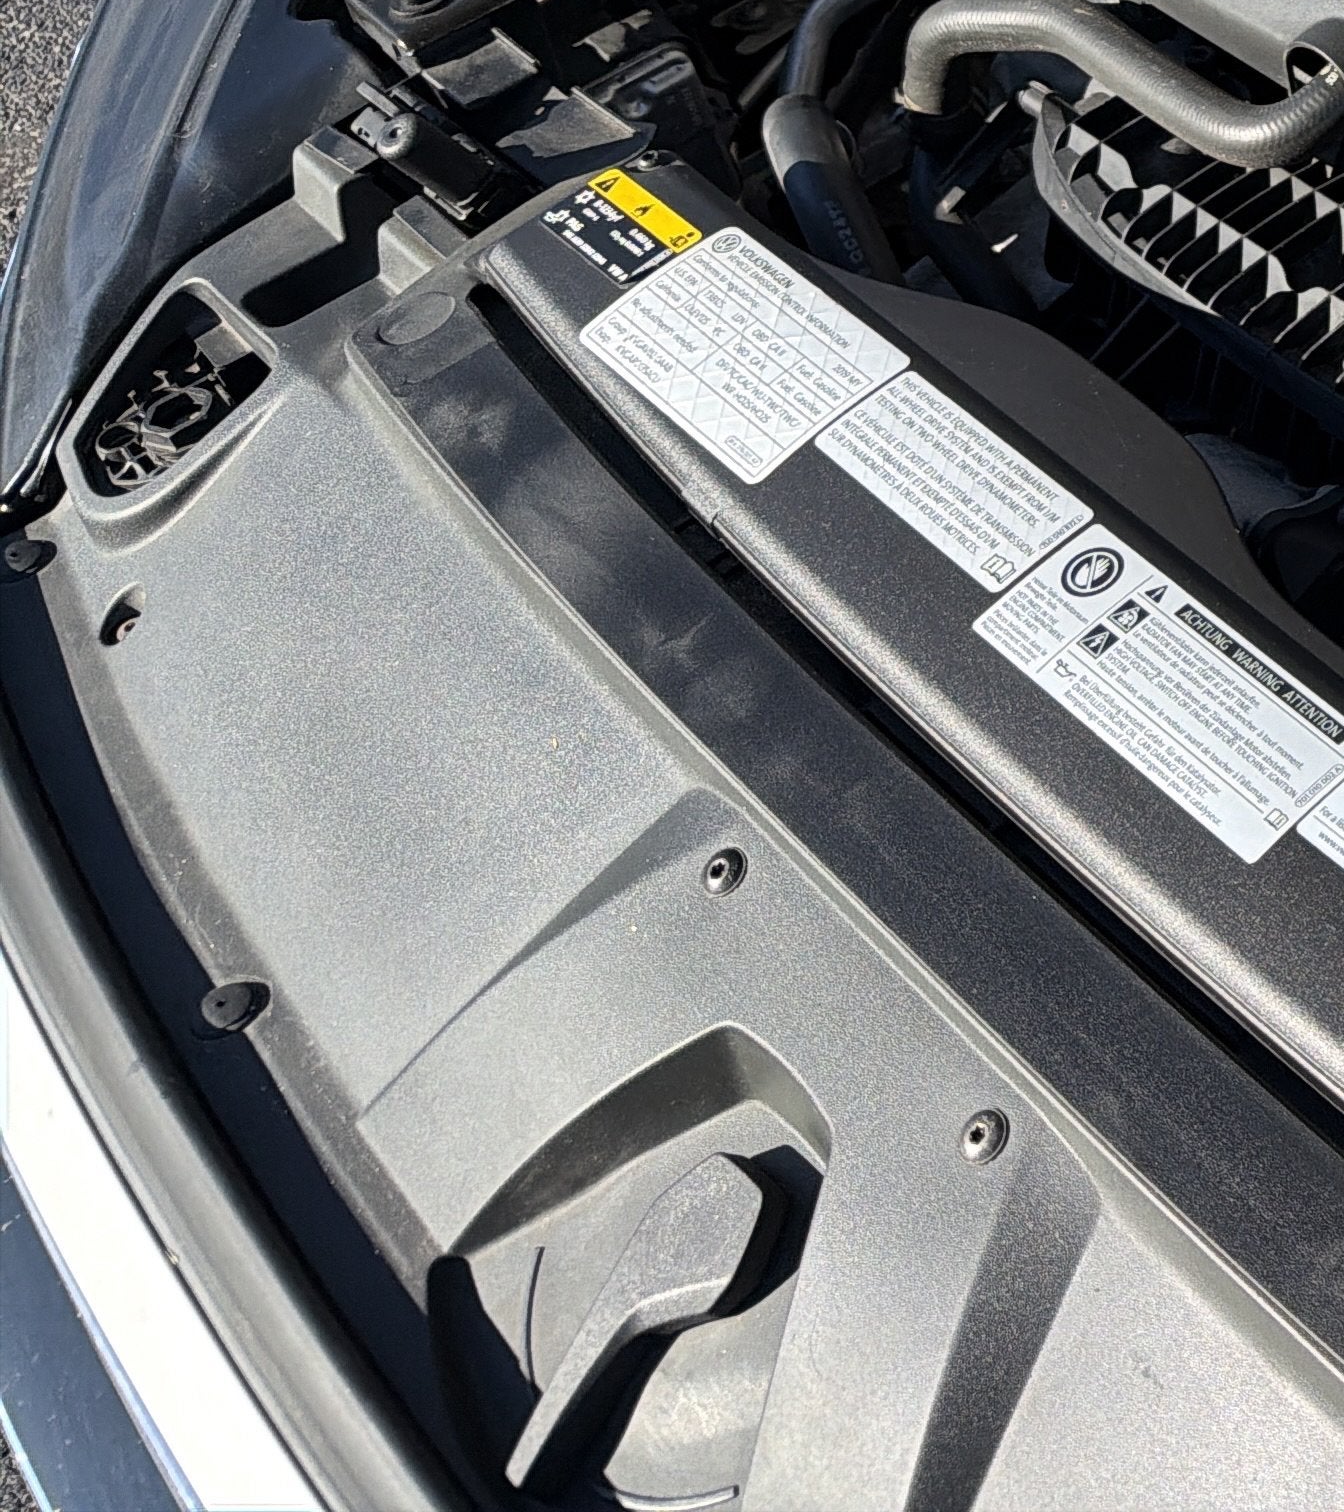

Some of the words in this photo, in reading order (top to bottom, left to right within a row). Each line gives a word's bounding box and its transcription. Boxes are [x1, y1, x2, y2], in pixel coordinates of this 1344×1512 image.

[736, 244, 795, 290] VOLKSWAGEN
[748, 269, 782, 295] EMISSION
[775, 290, 809, 317] CONTROL
[802, 311, 851, 350] INFORMATION
[830, 362, 852, 379] 2019
[898, 375, 920, 393] THIS
[810, 375, 843, 402] Gasoline
[885, 384, 928, 418] ALL-WHEEL
[914, 388, 948, 414] VEHICLE
[921, 412, 949, 435] DRIVE
[941, 409, 955, 420] IS
[942, 429, 975, 455] SYSTEM
[948, 415, 990, 448] EQUIPPED
[872, 392, 907, 420] TESTING
[899, 414, 919, 430] ON
[911, 423, 961, 464] TWO-WHEEL
[954, 458, 982, 481] DRIVE
[975, 475, 1042, 529] DYNAMOMETERS.
[967, 449, 992, 469] AND
[982, 442, 1009, 463] WITH
[1002, 457, 1017, 469] A
[851, 407, 868, 420] CE
[861, 414, 899, 445] VÉHICULE
[891, 439, 911, 455] EST
[904, 449, 930, 470] DOTÉ
[968, 502, 986, 516] DE
[978, 510, 1037, 558] TRANSMISSION
[872, 444, 918, 481] PERMANENT
[910, 475, 926, 488] ET
[918, 482, 955, 512] EXEMPTÉ
[984, 463, 999, 475] IS
[991, 468, 1027, 497] EXEMPT
[1008, 462, 1059, 503] PERMANENT
[826, 427, 848, 444] SUR
[897, 485, 925, 507] DEUX
[917, 501, 948, 527] ROUES
[939, 520, 983, 556] MOTRICES.
[1020, 491, 1048, 514] FROM
[1178, 605, 1235, 651] ACHTUNG
[1229, 646, 1286, 693] WARNING
[1279, 686, 1344, 739] ATTENTION
[1193, 665, 1216, 684] START
[1211, 679, 1224, 691] AT
[1218, 685, 1238, 702] ANY
[1232, 696, 1254, 715] TIME.
[1265, 770, 1299, 799] IGNITION
[1317, 804, 1335, 819] For
[1328, 813, 1340, 823] a
